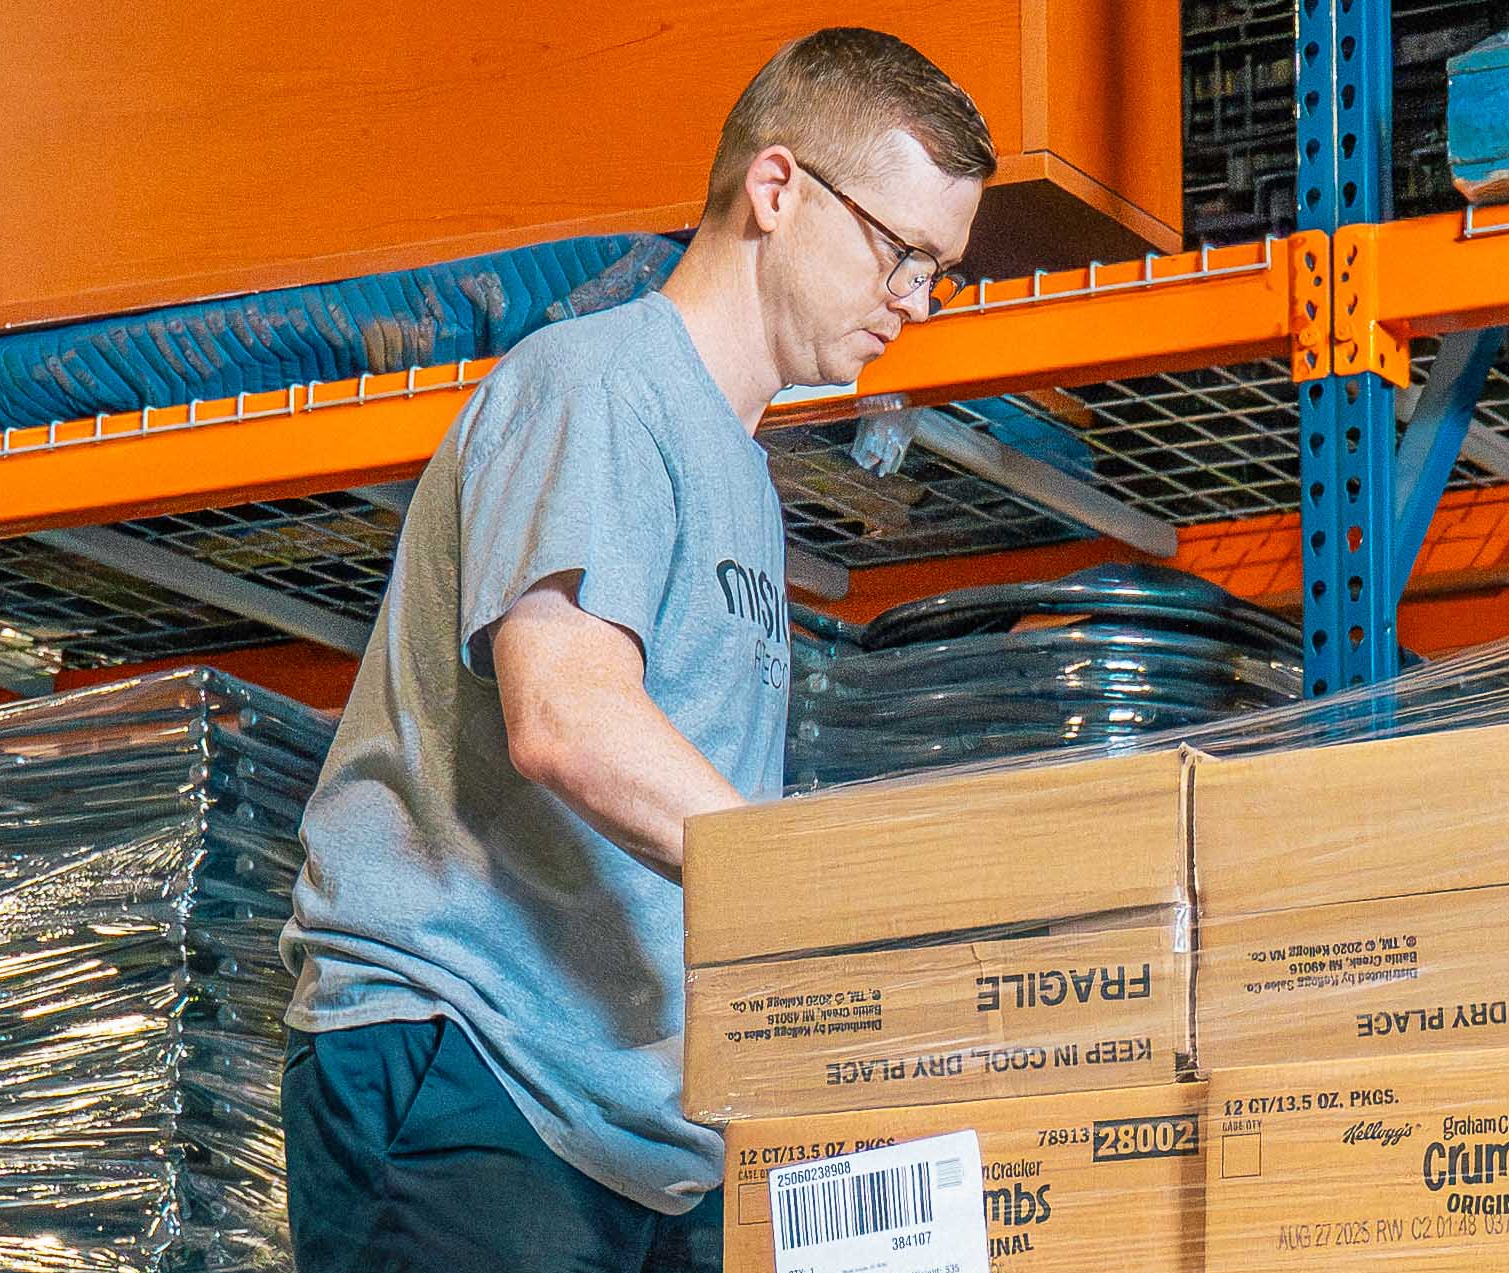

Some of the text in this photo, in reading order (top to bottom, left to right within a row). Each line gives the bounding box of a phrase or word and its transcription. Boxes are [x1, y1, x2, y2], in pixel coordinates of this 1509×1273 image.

[1289, 961, 1328, 976] 49016
[978, 963, 1152, 1012] FRAGILE
[1357, 1007, 1446, 1037] PLACE
[1452, 1001, 1506, 1028] DRY
[827, 1037, 1153, 1085] KEEP IN COOL, DRY PLACE
[1037, 1121, 1198, 1156] 78913 28002
[1343, 1121, 1414, 1147] Kellogg's
[777, 1161, 851, 1188] 25060238908
[892, 1231, 933, 1251] 384107
